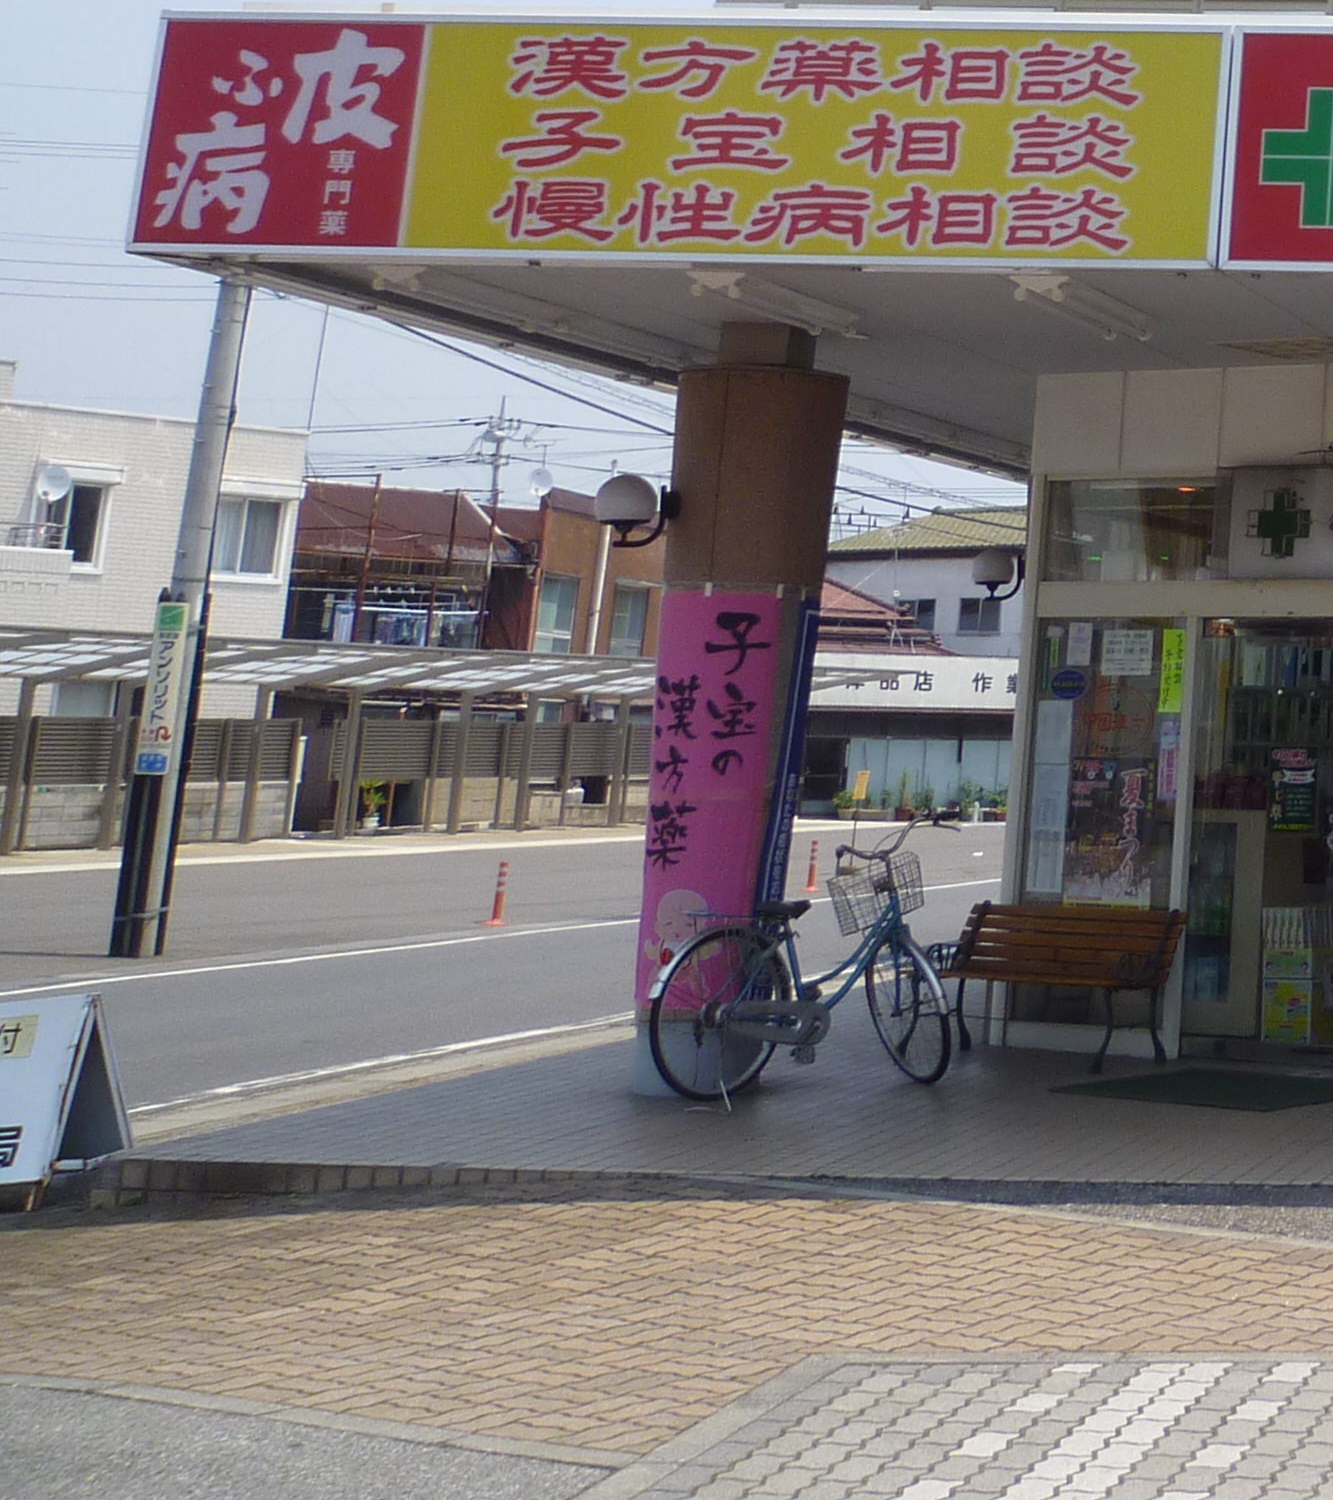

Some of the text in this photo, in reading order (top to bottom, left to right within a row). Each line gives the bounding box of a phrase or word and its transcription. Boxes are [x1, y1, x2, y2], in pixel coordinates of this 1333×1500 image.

[510, 36, 1141, 107] 漢方薬相談
[499, 109, 1136, 182] 子宝相談
[318, 147, 355, 238] 専門薬
[490, 178, 1132, 254] 慢性病相談
[704, 610, 772, 777] 子宝の
[646, 675, 701, 871] 漢方薬
